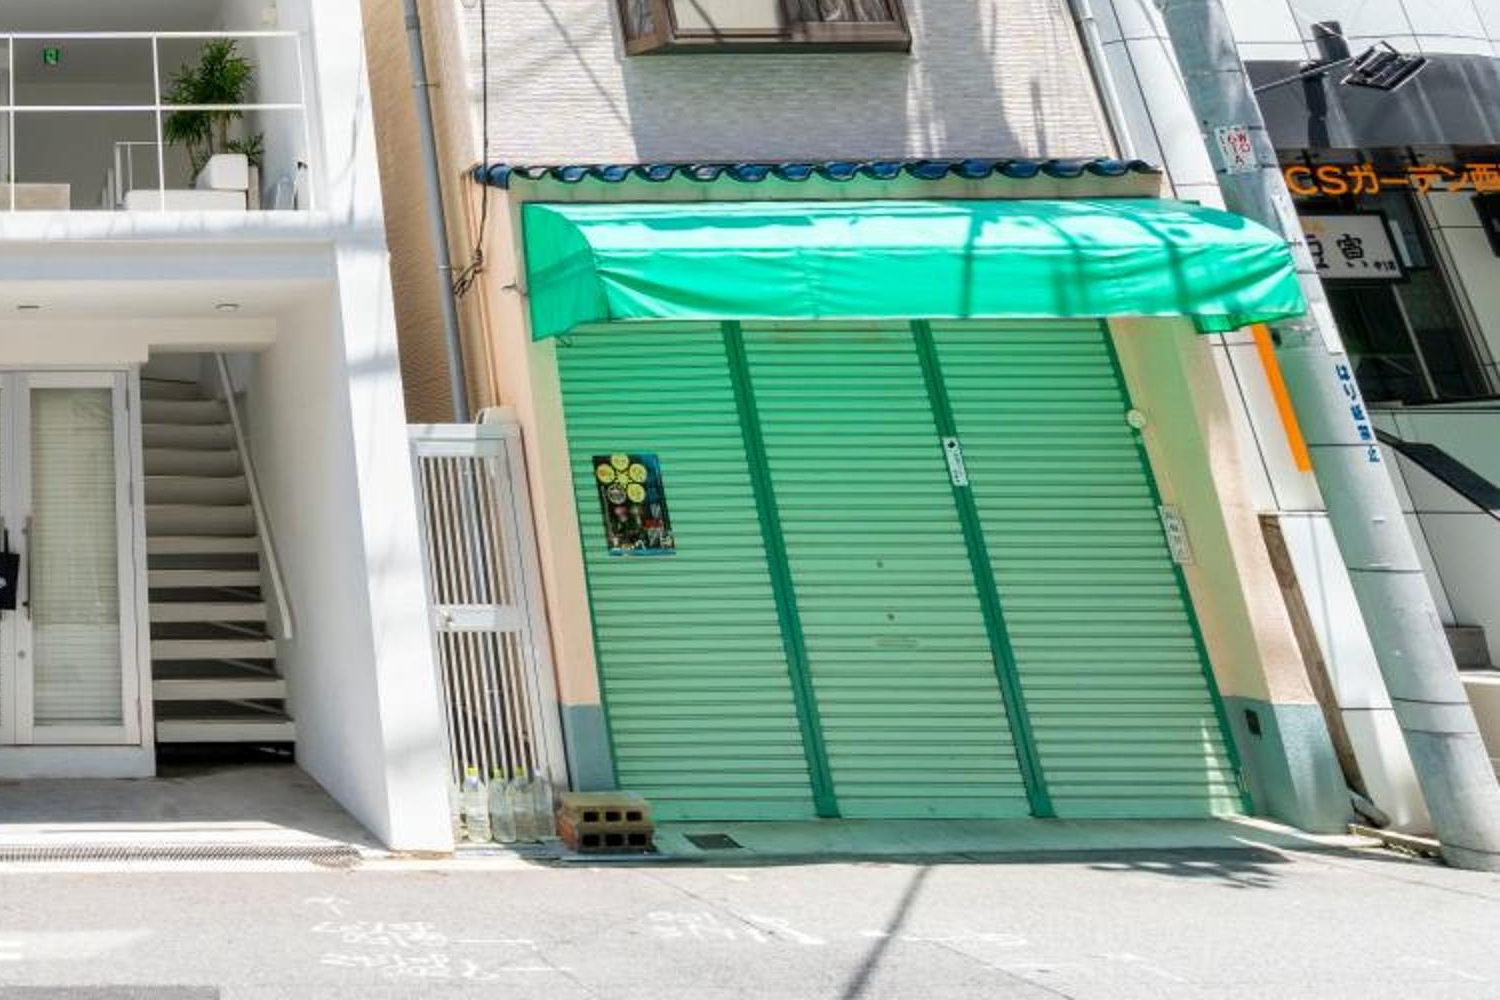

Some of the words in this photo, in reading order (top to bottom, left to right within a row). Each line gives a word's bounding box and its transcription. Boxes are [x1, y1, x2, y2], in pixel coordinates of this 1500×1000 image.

[1284, 163, 1500, 195] CSガーデン西
